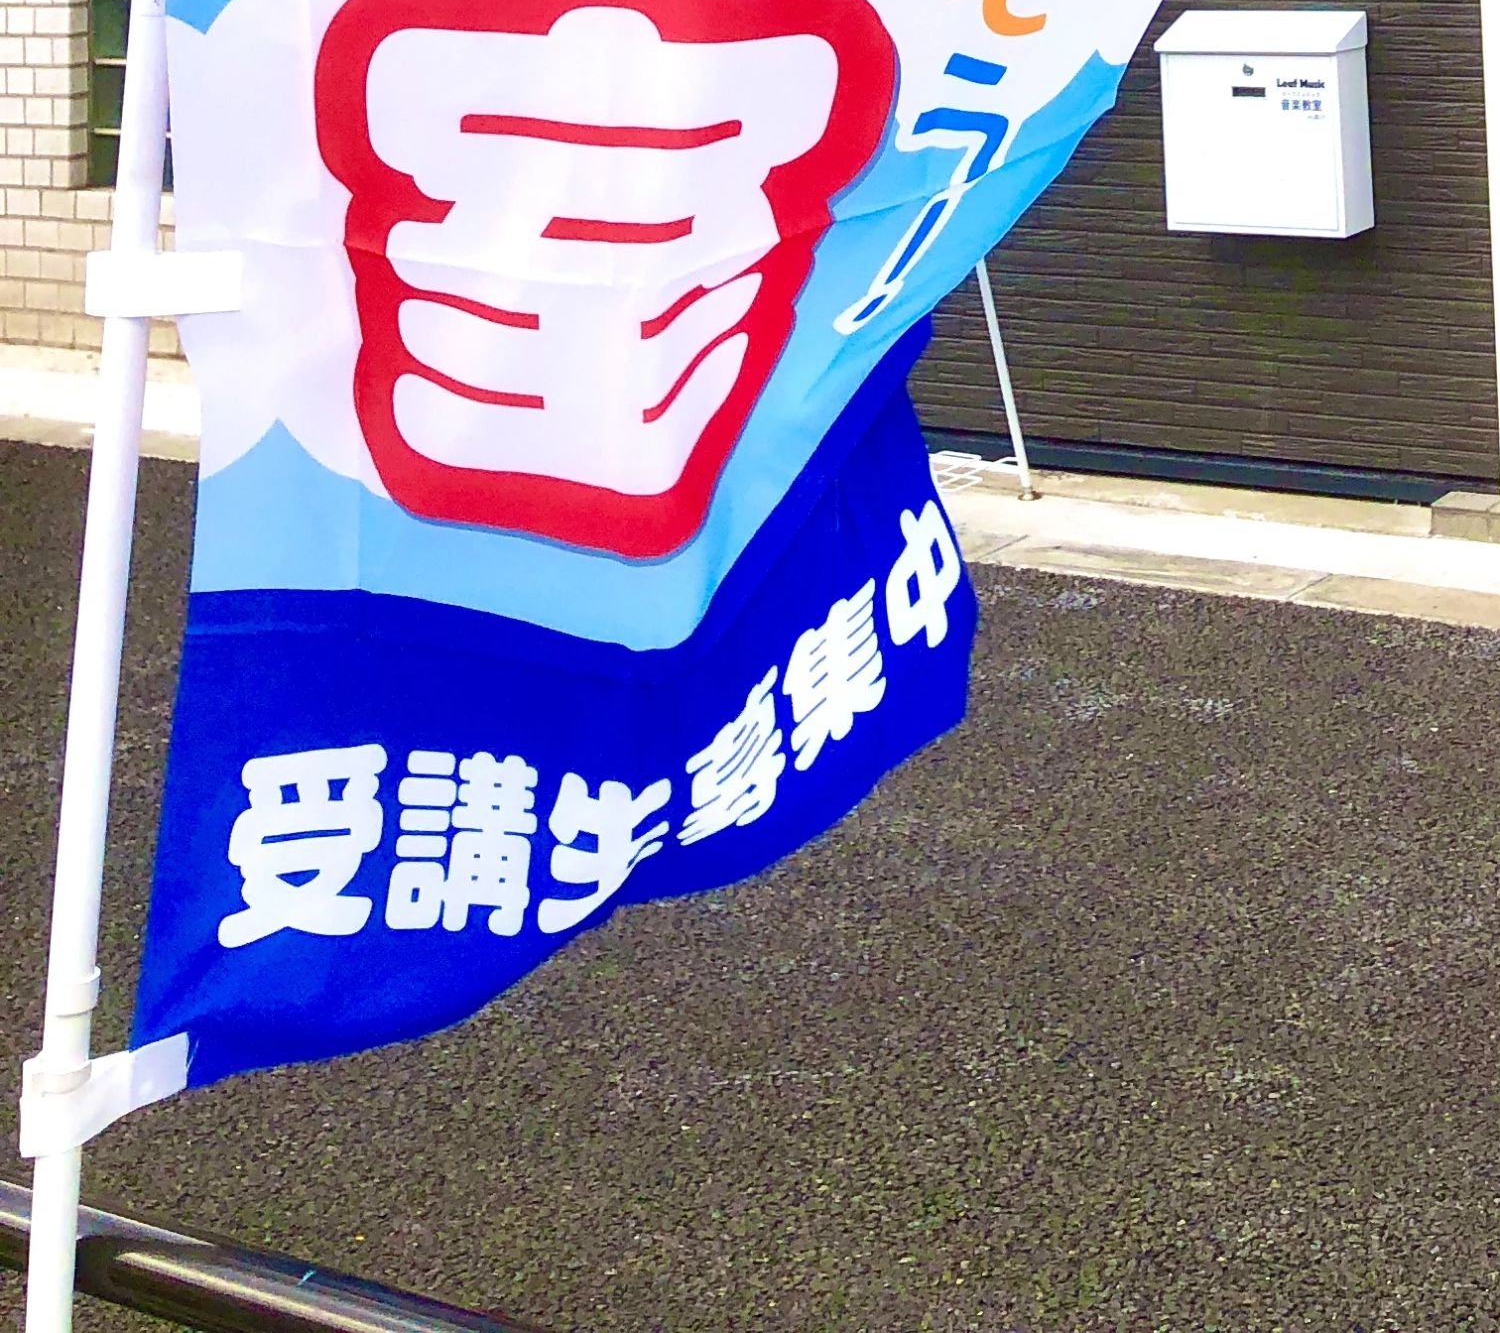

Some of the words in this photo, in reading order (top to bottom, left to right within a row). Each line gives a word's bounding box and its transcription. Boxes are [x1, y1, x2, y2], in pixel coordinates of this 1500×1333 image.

[218, 499, 962, 949] 受講生募集中
